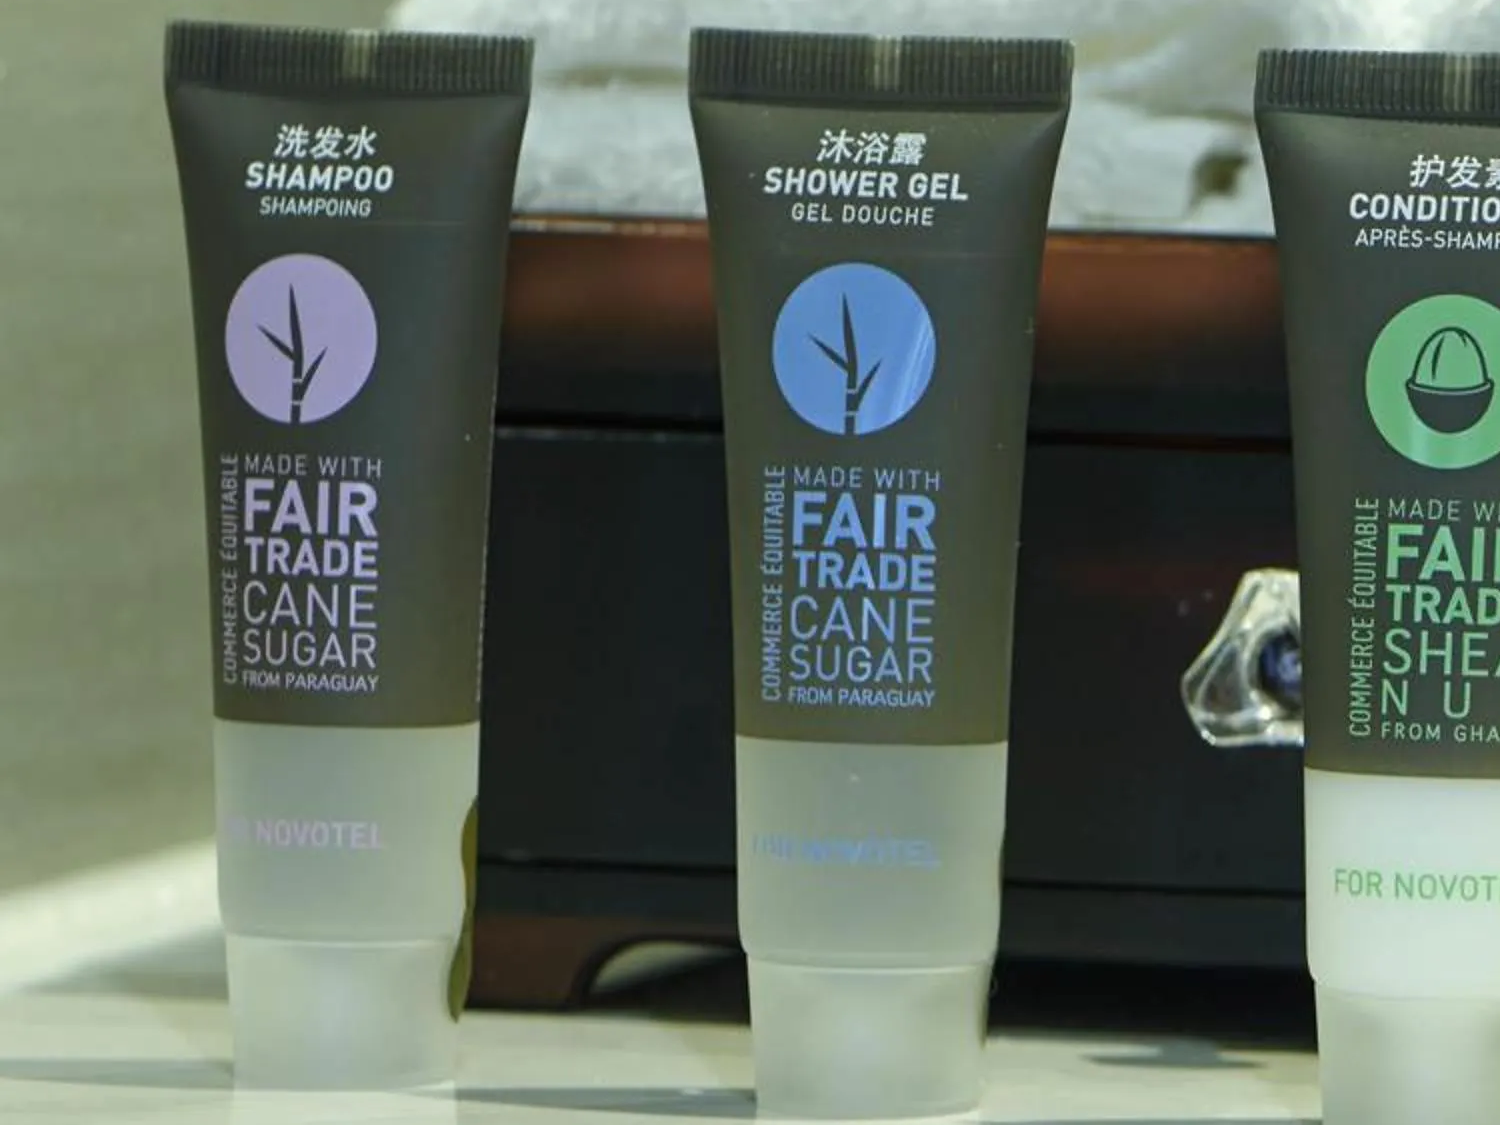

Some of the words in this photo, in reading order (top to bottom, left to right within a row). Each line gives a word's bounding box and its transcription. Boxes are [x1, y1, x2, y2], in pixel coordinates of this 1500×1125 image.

[273, 124, 378, 160] 洗发水
[816, 129, 927, 166] 沐浴露
[245, 161, 394, 192] SHAMPOO
[763, 167, 897, 199] SHOWER
[908, 172, 969, 201] GEL
[260, 196, 372, 217] SHAMPOING
[791, 202, 833, 222] GEL
[842, 204, 935, 227] DOUCHE
[245, 454, 308, 475] MADE
[318, 456, 383, 478] WITH
[793, 466, 863, 488] MADE
[874, 469, 940, 491] WITH
[244, 478, 379, 536] FAIR
[792, 490, 937, 550] FAIR
[1388, 498, 1462, 522] MADE
[244, 537, 379, 578] TRADE
[792, 550, 937, 592] TRADE
[1348, 497, 1379, 609] ÉQUITABLE
[243, 580, 378, 629] CANE
[790, 595, 935, 644] CANE
[222, 568, 238, 684] COMMERCE
[762, 583, 783, 701] COMMERCE
[243, 628, 377, 669] SUGAR
[789, 644, 933, 684] SUGAR
[242, 670, 280, 689] FROM
[285, 672, 379, 692] PARAGUAY
[1349, 616, 1375, 737] COMMERCE
[788, 686, 832, 705] FROM
[838, 688, 935, 708] PARAGUAY
[1381, 722, 1441, 740] FROM
[255, 818, 384, 850] NOVOTEL
[1334, 868, 1383, 898] FOR
